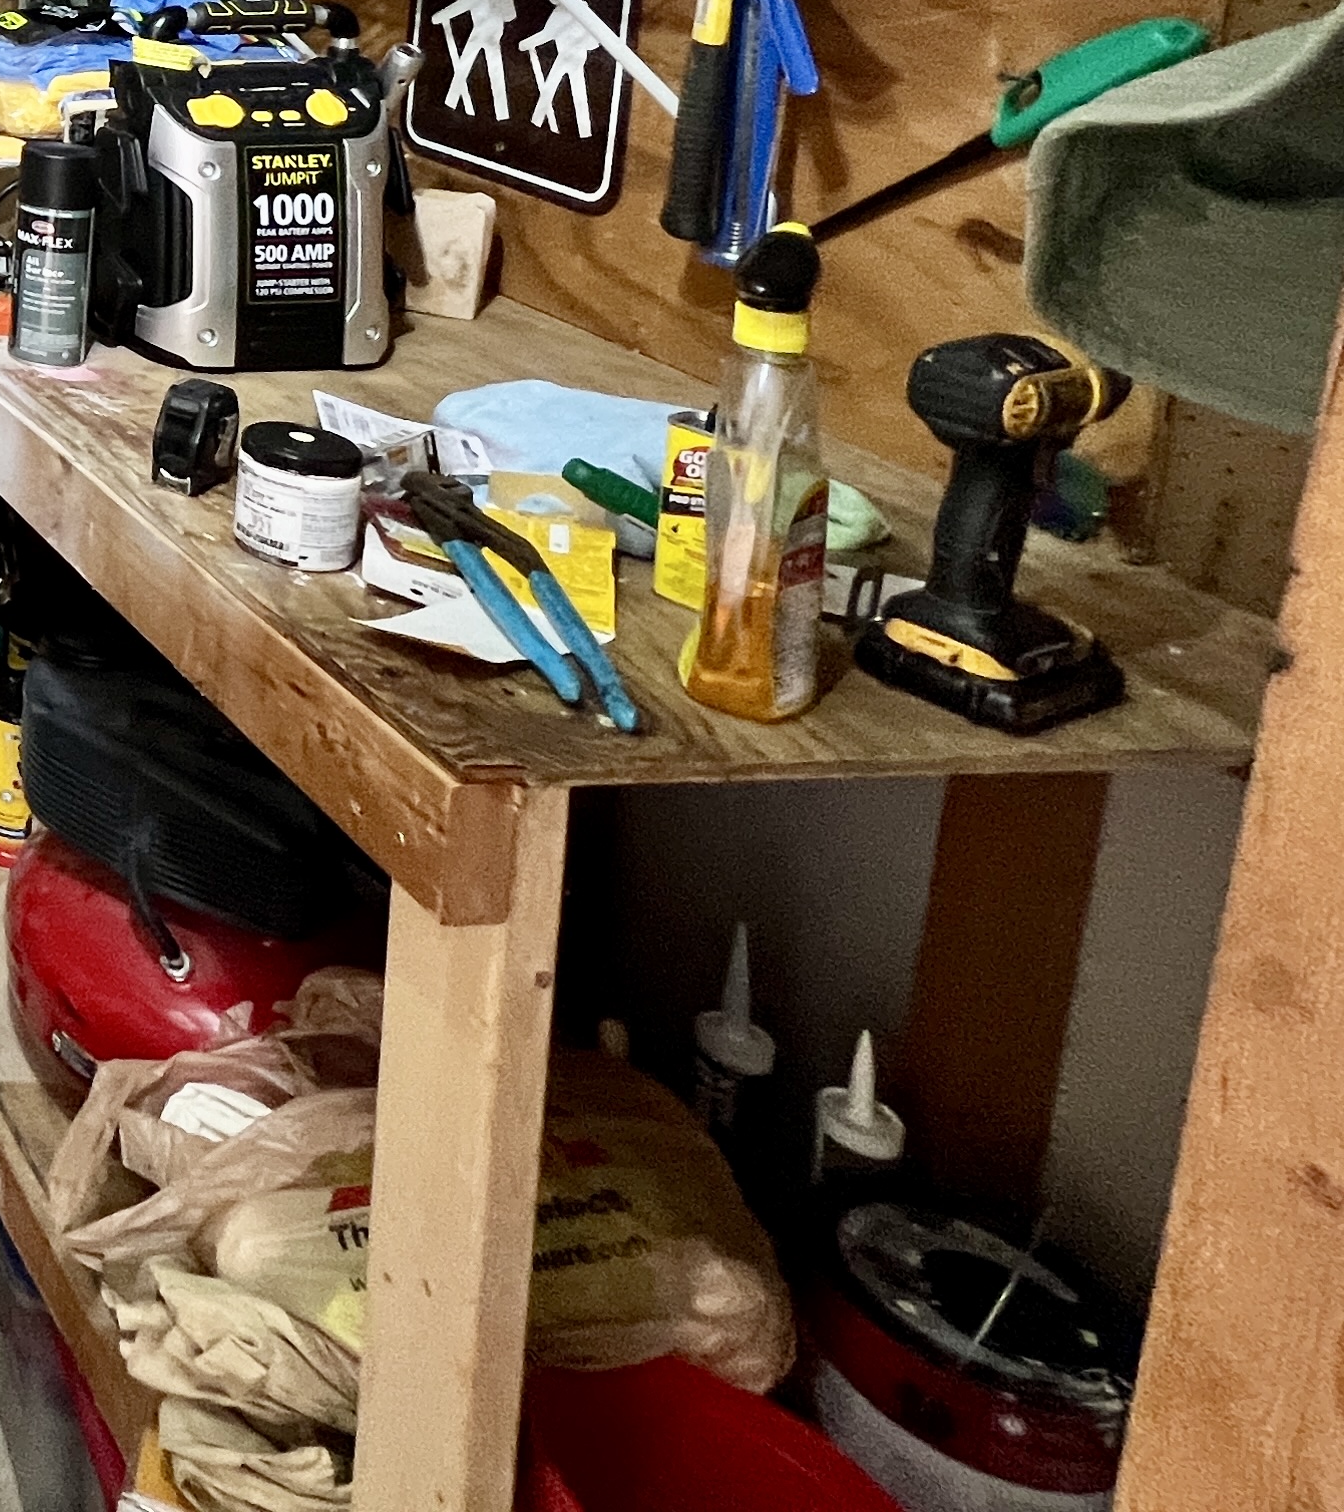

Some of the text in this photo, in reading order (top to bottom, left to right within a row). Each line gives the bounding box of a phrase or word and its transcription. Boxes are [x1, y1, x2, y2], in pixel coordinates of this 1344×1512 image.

[251, 154, 332, 170] STANLEY
[264, 171, 322, 186] JUMPIT
[252, 192, 335, 227] 1000
[254, 243, 335, 263] 500 AMP
